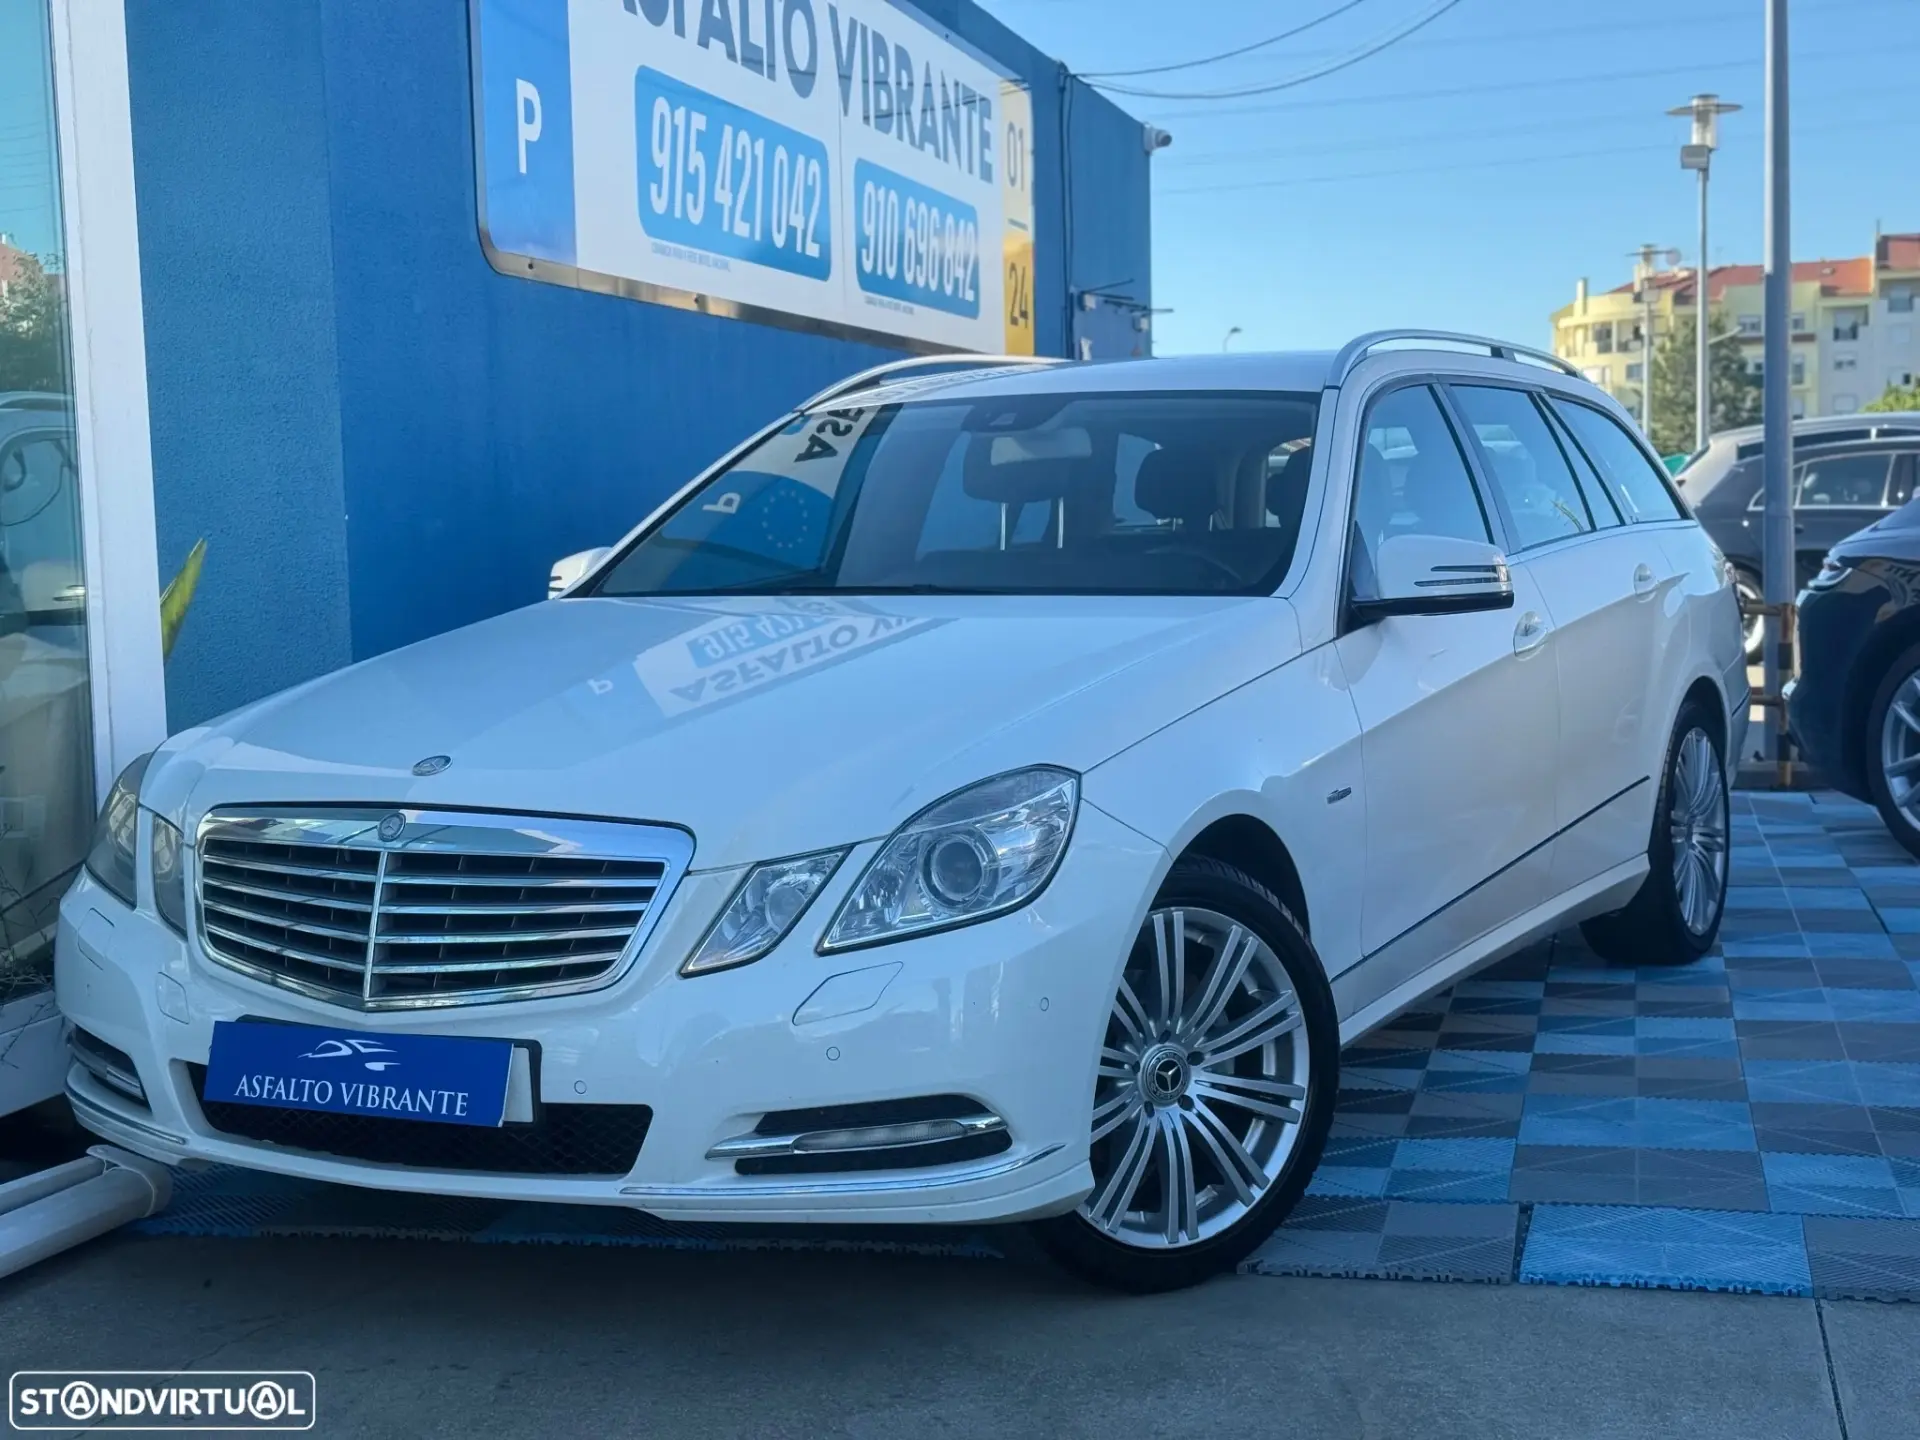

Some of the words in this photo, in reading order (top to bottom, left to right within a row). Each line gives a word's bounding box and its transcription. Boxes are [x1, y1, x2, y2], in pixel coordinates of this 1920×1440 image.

[516, 78, 542, 175] P
[623, 0, 818, 99] ALTO
[829, 3, 994, 184] VIBRANTE
[650, 96, 707, 225] 915
[714, 124, 764, 241] 421
[772, 145, 822, 258] 042
[1006, 121, 1025, 191] 01
[861, 180, 898, 280] 910
[903, 196, 940, 292] 696
[1008, 262, 1029, 329] 24
[234, 1074, 333, 1104] ASFALTO
[340, 1082, 469, 1117] VIBRANTE
